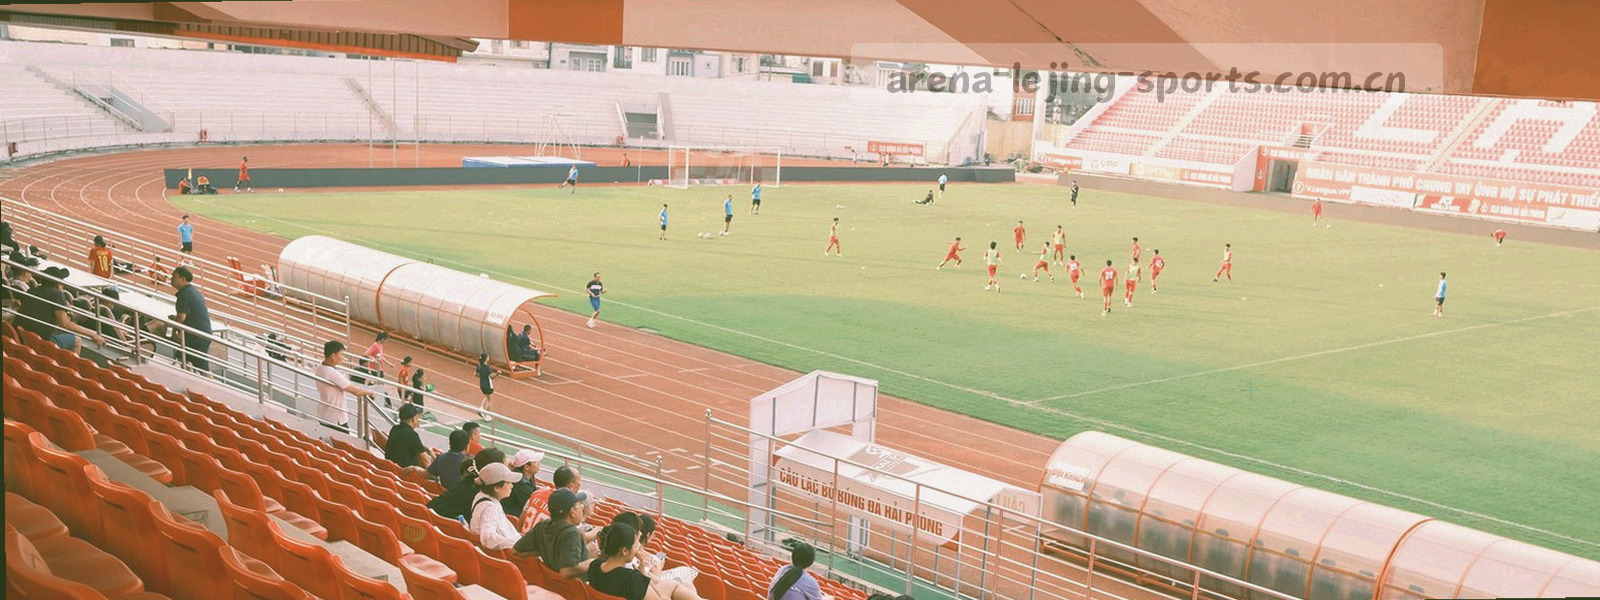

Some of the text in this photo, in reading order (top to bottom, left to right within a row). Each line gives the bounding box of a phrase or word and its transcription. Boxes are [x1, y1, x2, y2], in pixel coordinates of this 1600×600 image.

[1415, 178, 1452, 194] CHUNG
[1454, 181, 1472, 195] TAY
[1537, 189, 1569, 205] PHÁT
[780, 467, 798, 487] CÂU
[801, 475, 819, 496] LẠC
[837, 487, 865, 510] BÓNG
[867, 497, 882, 516] ĐÁ
[884, 501, 902, 523] HẢI
